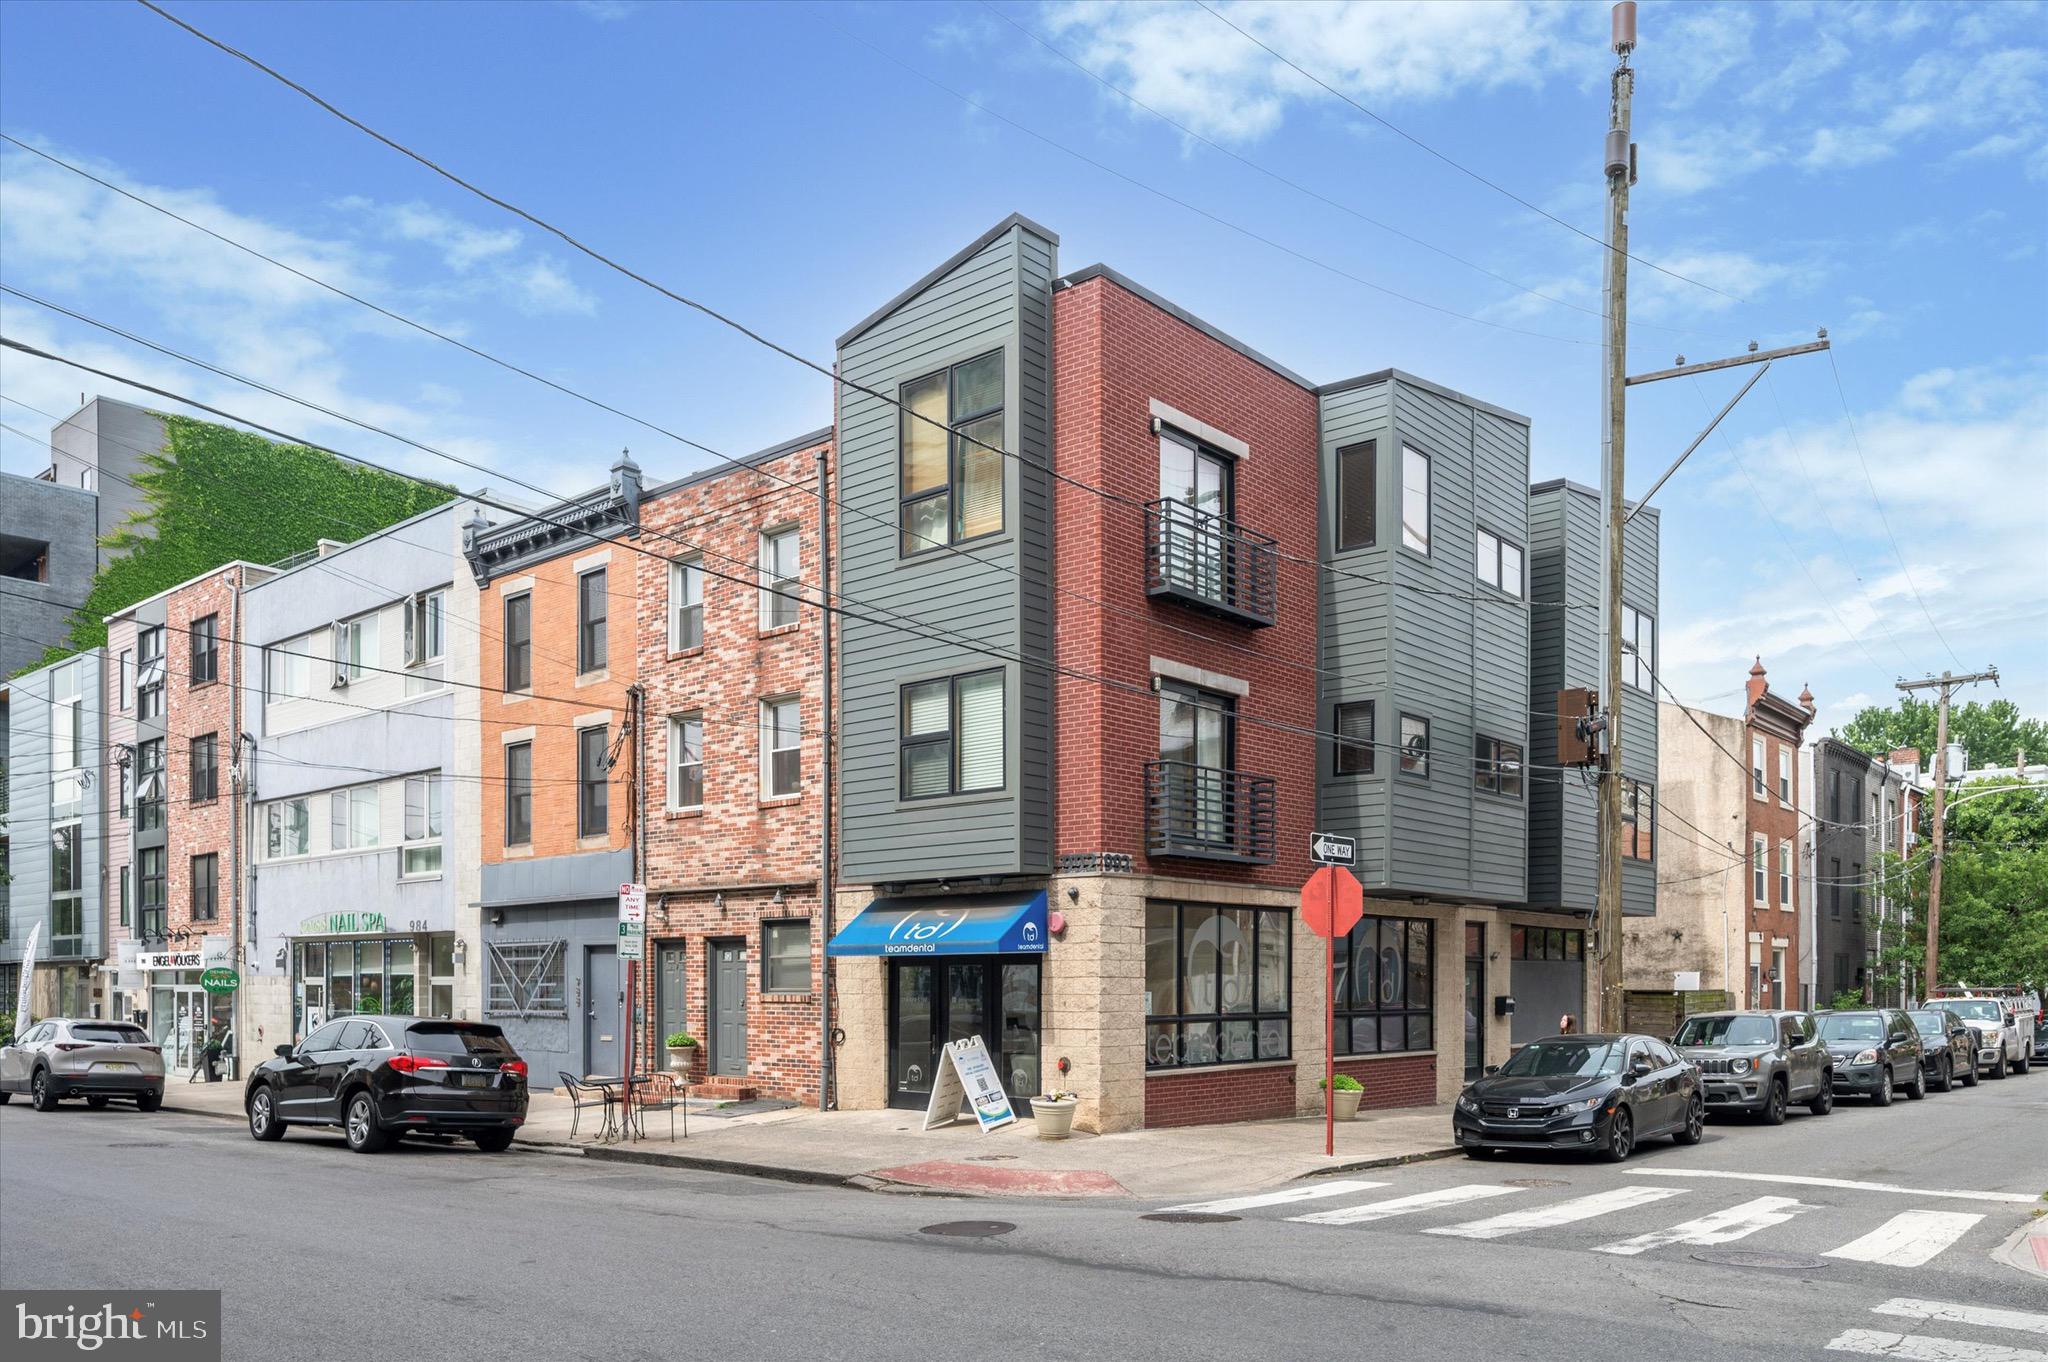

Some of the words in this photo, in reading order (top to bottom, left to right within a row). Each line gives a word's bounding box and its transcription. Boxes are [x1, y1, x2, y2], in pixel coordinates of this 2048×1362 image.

[1323, 843, 1336, 855] ONE
[1337, 845, 1350, 857] WAY
[1103, 853, 1131, 873] 992
[621, 885, 630, 895] NO
[330, 913, 359, 933] NAIL
[361, 911, 385, 932] SPA
[409, 920, 428, 931] 984
[621, 924, 626, 935] 3
[885, 943, 935, 953] teamdental
[204, 979, 237, 987] NAILS
